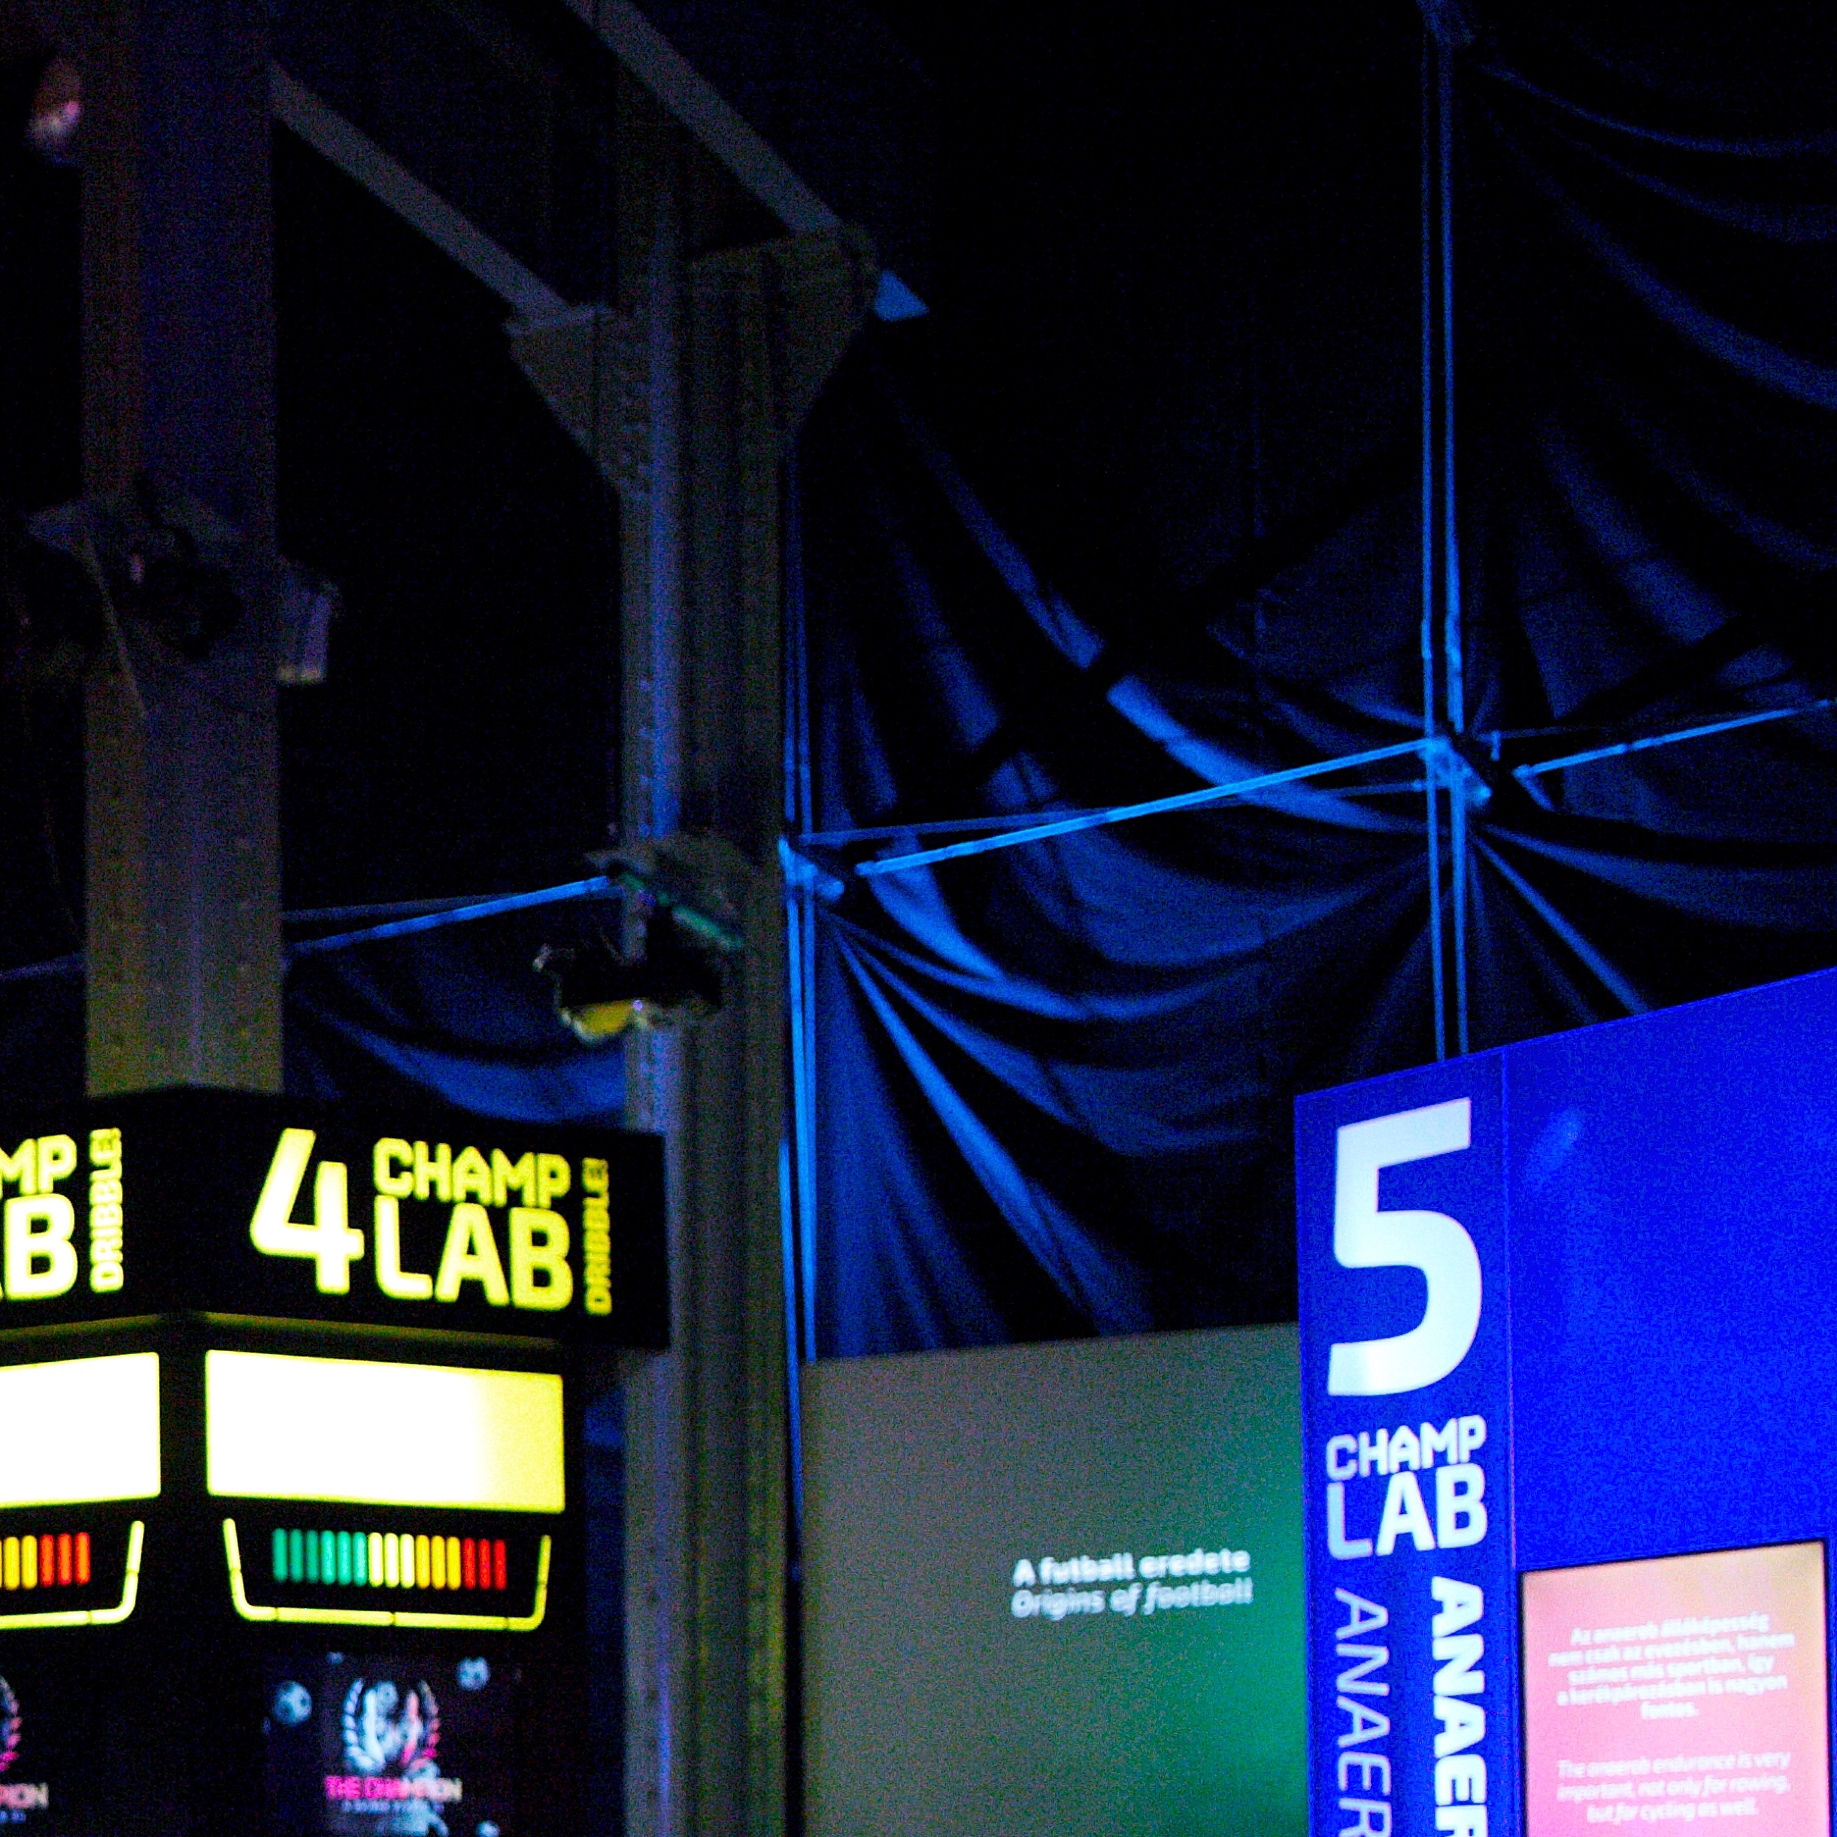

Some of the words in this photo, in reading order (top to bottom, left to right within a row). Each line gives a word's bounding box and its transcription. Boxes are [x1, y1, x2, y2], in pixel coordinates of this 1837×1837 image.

[249, 1127, 365, 1295] 4
[372, 1137, 572, 1209] CHAMP
[373, 1195, 574, 1311] LAB
[1326, 1097, 1482, 1397] 5
[1326, 1414, 1487, 1481] CHAMP
[1327, 1462, 1488, 1560] LAB
[1011, 1585, 1106, 1621] Origins
[1109, 1581, 1143, 1616] of
[1142, 1575, 1254, 1615] football
[1012, 1558, 1036, 1587] A
[1039, 1552, 1136, 1585] futball
[1138, 1547, 1251, 1578] eredete
